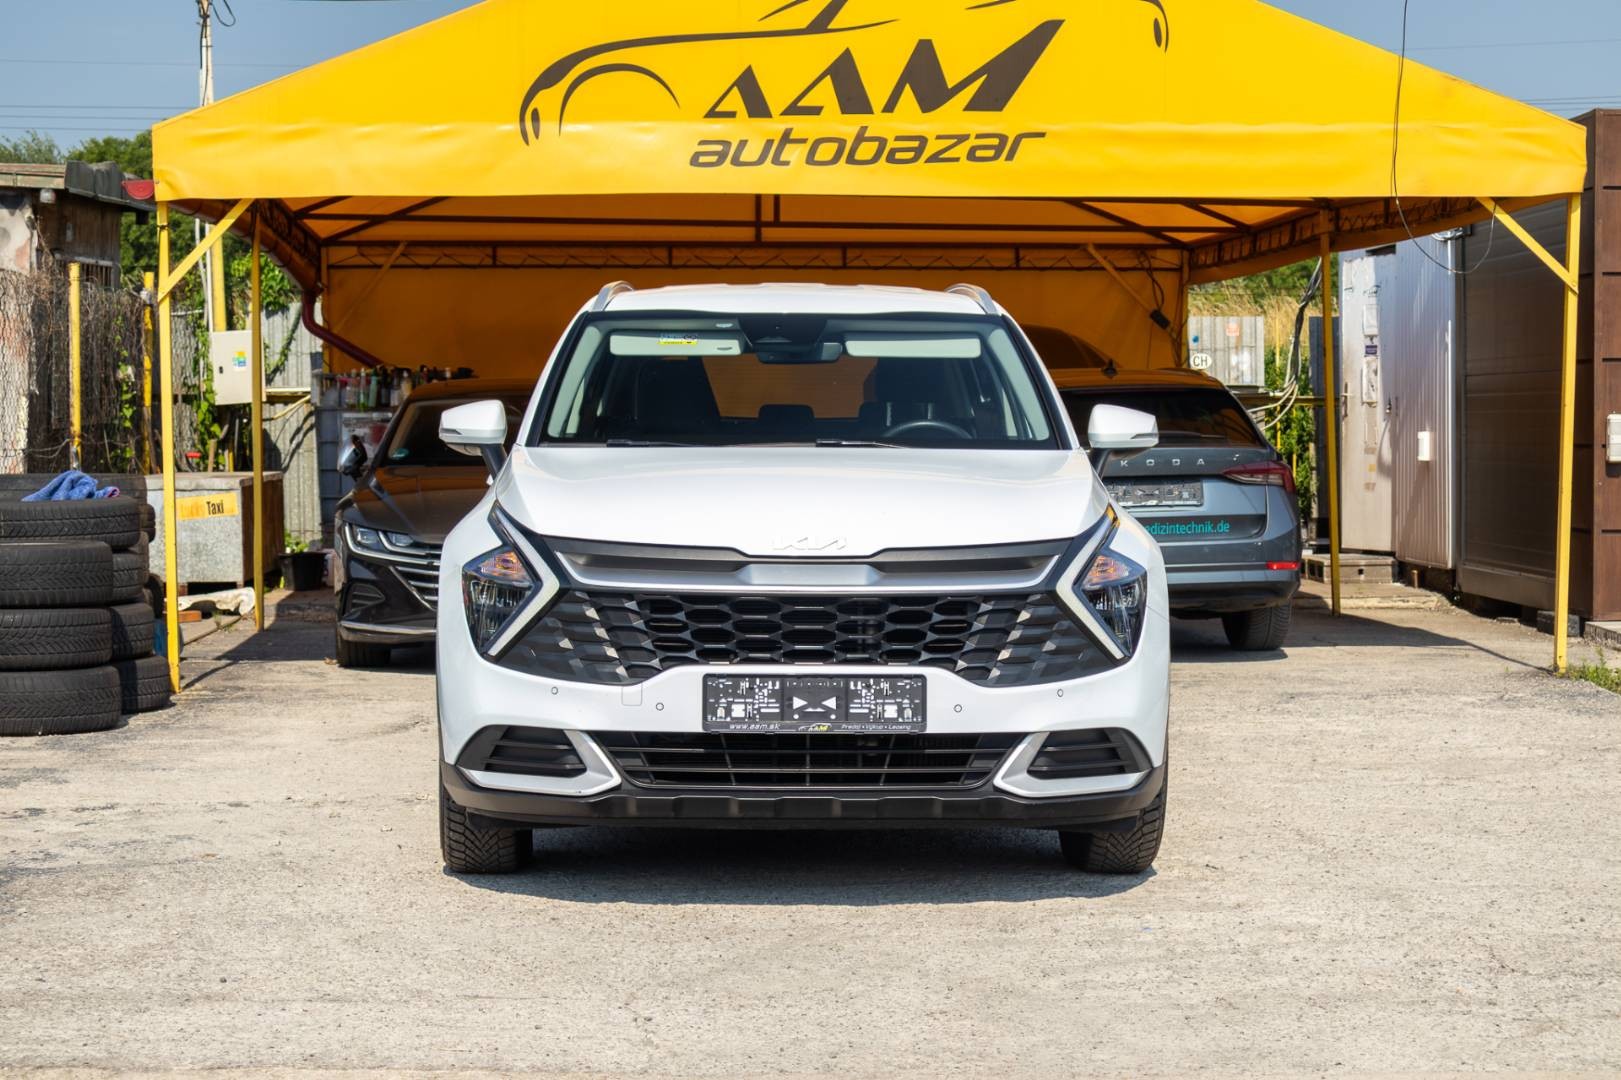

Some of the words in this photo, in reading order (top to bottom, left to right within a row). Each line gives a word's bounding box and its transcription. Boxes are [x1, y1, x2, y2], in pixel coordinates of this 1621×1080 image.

[703, 19, 1066, 119] AAM
[689, 126, 1047, 168] autobazar
[1193, 355, 1208, 367] CH
[1120, 458, 1205, 467] KODA
[206, 500, 224, 515] Taxi
[1145, 520, 1230, 535] edizintechnik.de
[729, 723, 780, 731] www.aam.sk
